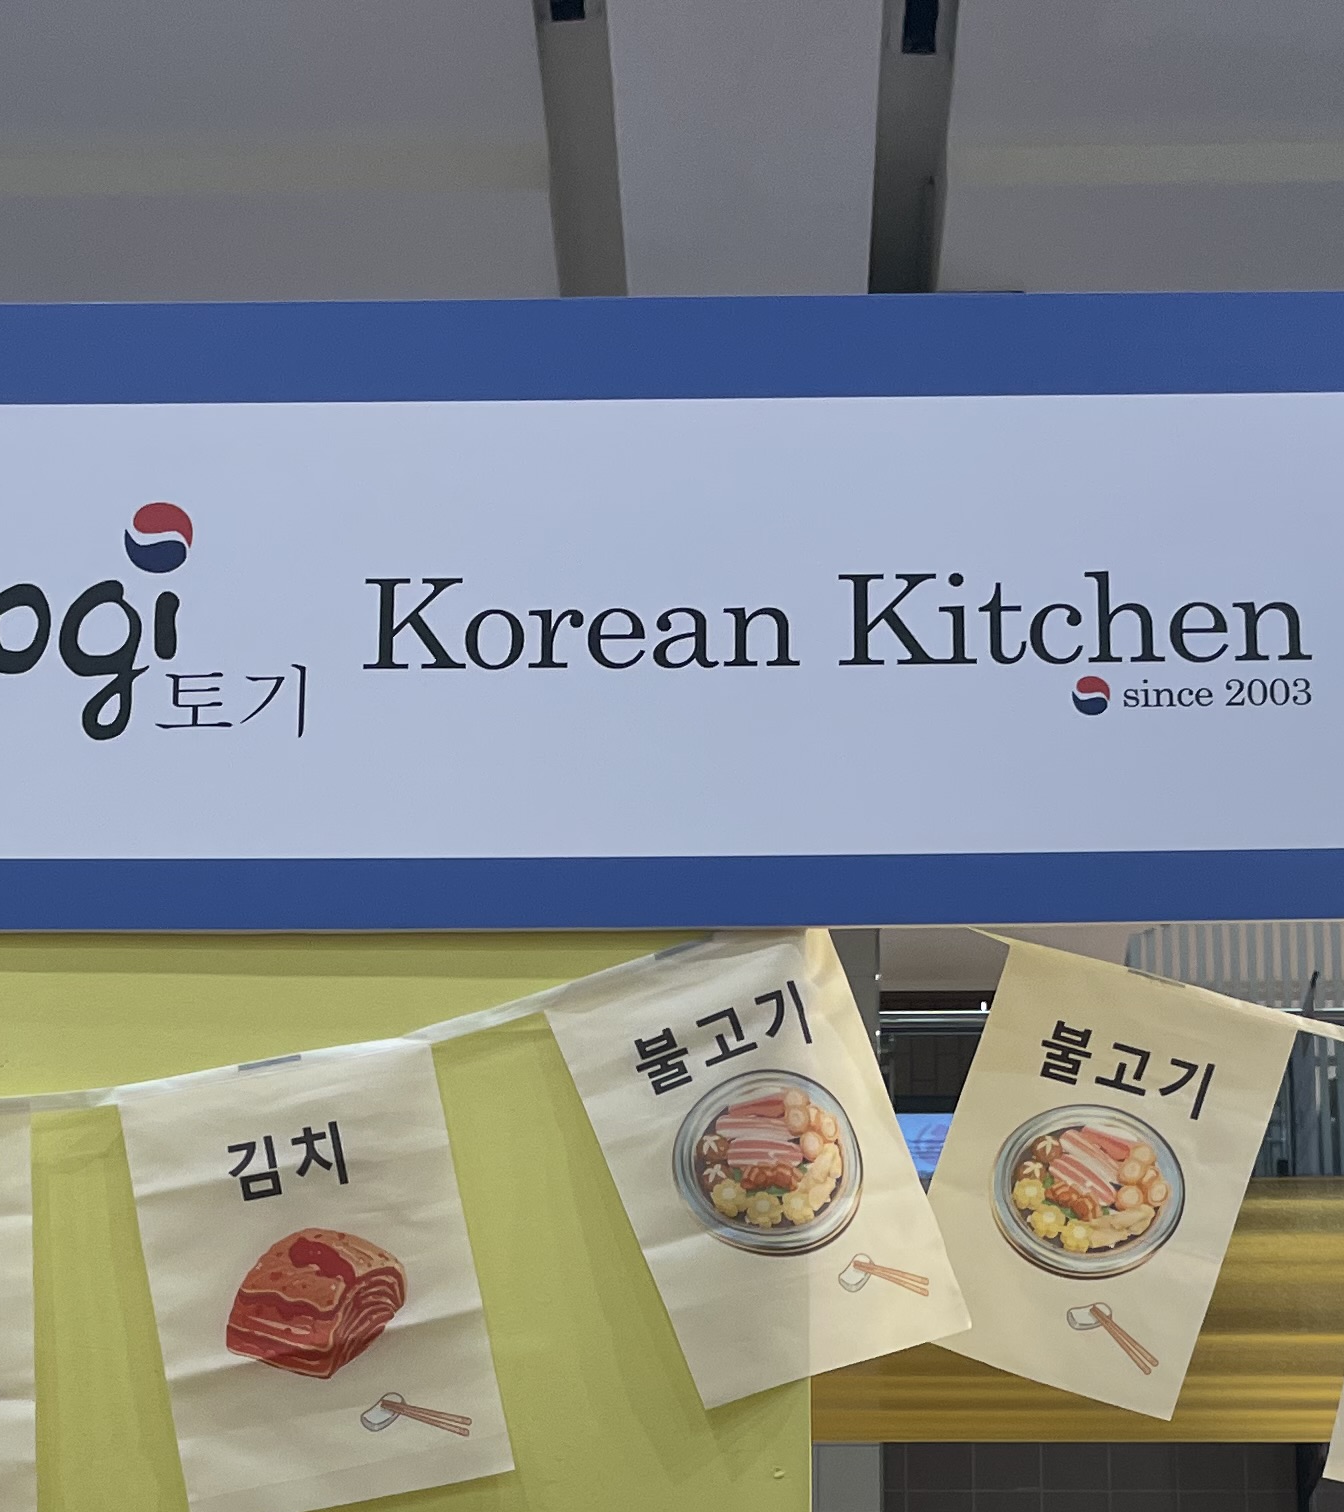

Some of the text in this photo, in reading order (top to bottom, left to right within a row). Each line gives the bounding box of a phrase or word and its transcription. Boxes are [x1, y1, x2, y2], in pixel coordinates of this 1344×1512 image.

[362, 571, 1313, 673] Korean Kitchen
[155, 663, 307, 739] 토기
[1123, 677, 1313, 708] since 2003
[634, 981, 815, 1096] 불고기
[1038, 1020, 1217, 1120] 불고기
[226, 1120, 350, 1202] 김치
